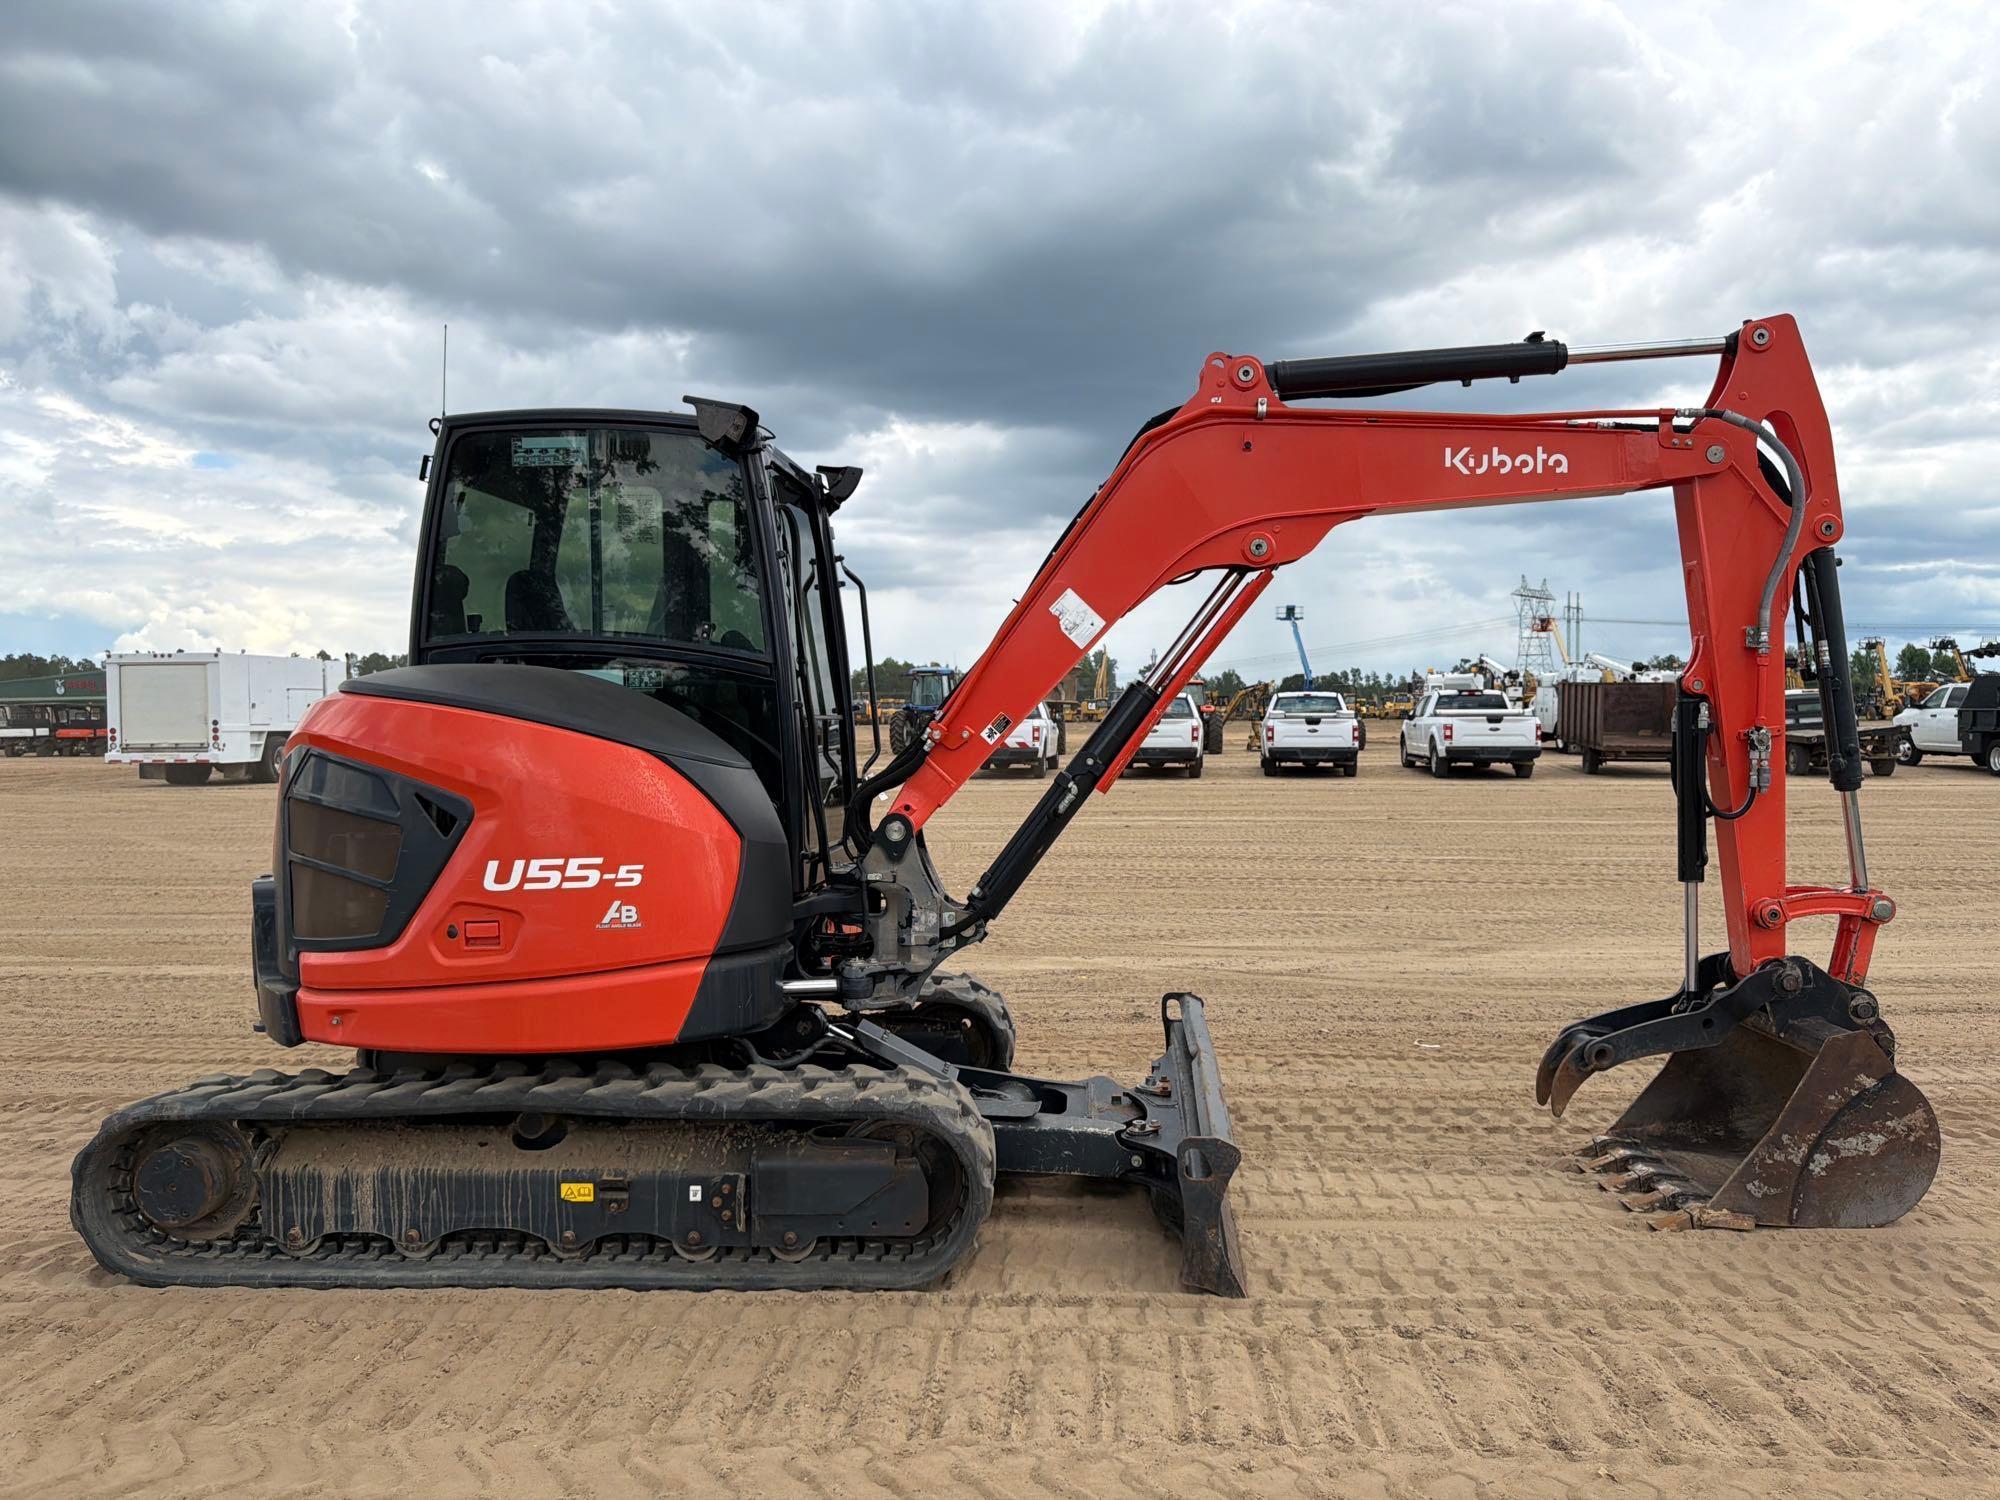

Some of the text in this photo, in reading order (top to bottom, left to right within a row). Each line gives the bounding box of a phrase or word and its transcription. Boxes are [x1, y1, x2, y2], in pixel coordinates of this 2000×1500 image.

[1444, 446, 1569, 475] Kubota
[483, 857, 644, 891] U55-5
[601, 900, 639, 924] AB
